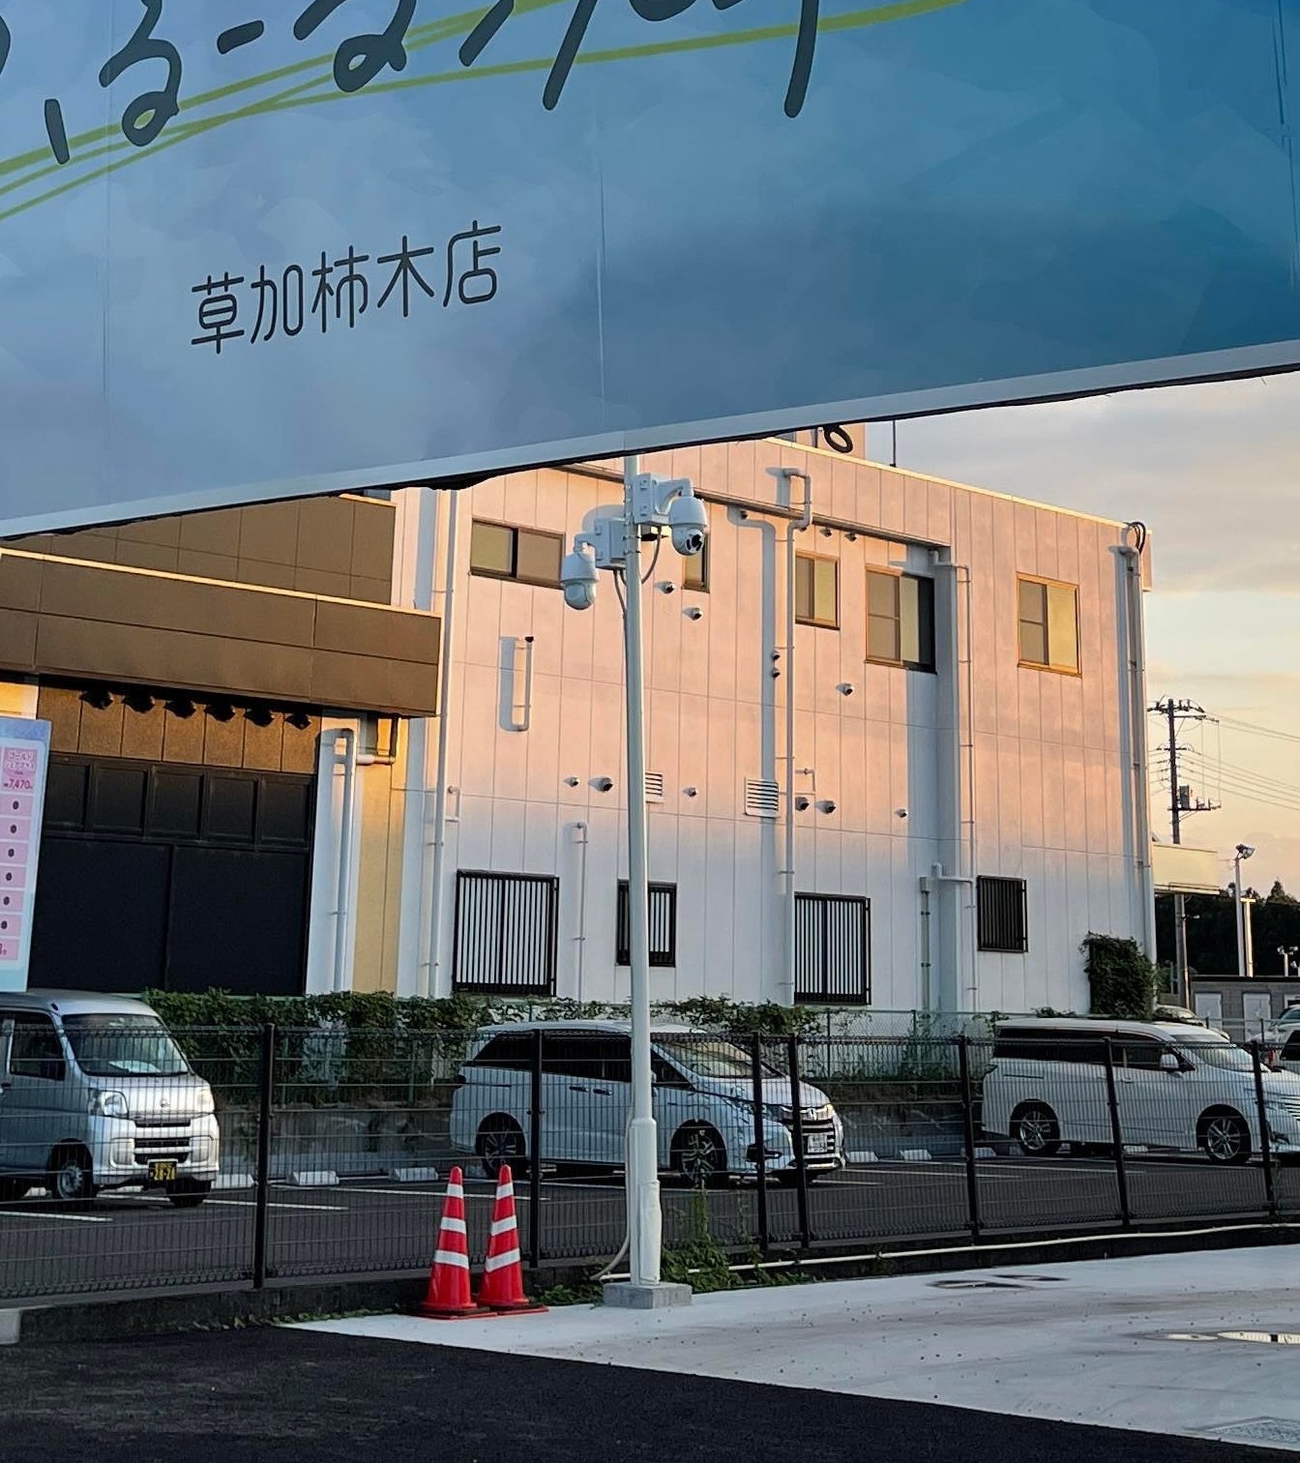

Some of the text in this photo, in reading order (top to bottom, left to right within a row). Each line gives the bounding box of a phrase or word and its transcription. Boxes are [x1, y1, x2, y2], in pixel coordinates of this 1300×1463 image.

[191, 222, 502, 354] 草加柿木店
